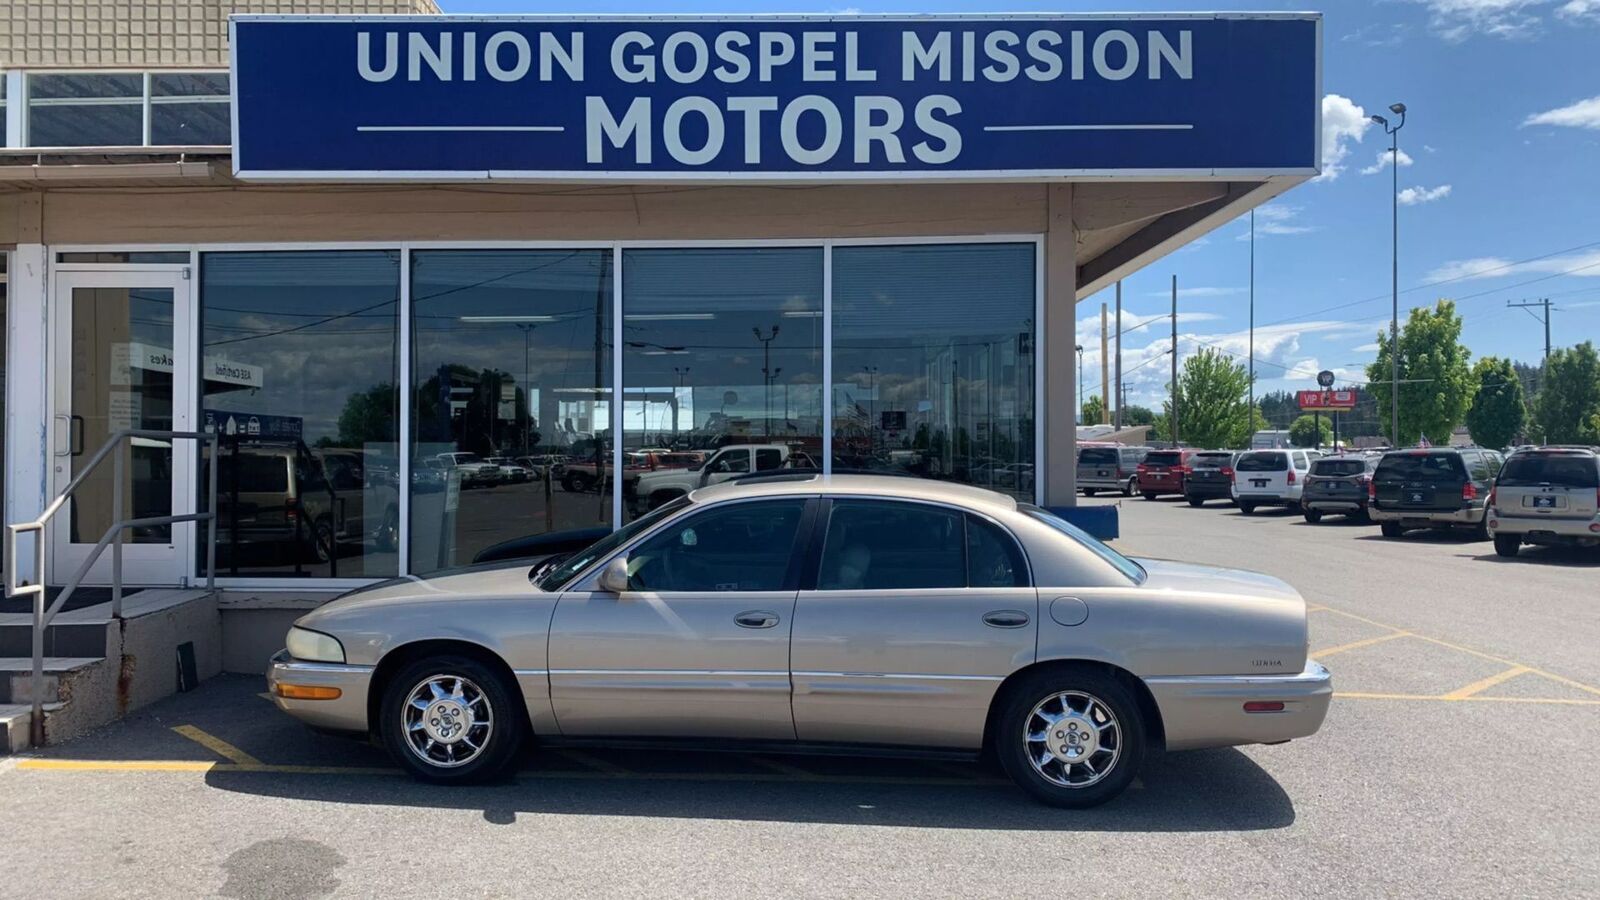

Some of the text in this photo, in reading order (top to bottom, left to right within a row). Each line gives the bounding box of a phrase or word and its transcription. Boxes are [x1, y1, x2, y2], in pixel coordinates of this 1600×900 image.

[357, 30, 1193, 84] UNION GOSPEL MISSION
[585, 94, 963, 165] MOTORS
[1304, 394, 1317, 404] VIP
